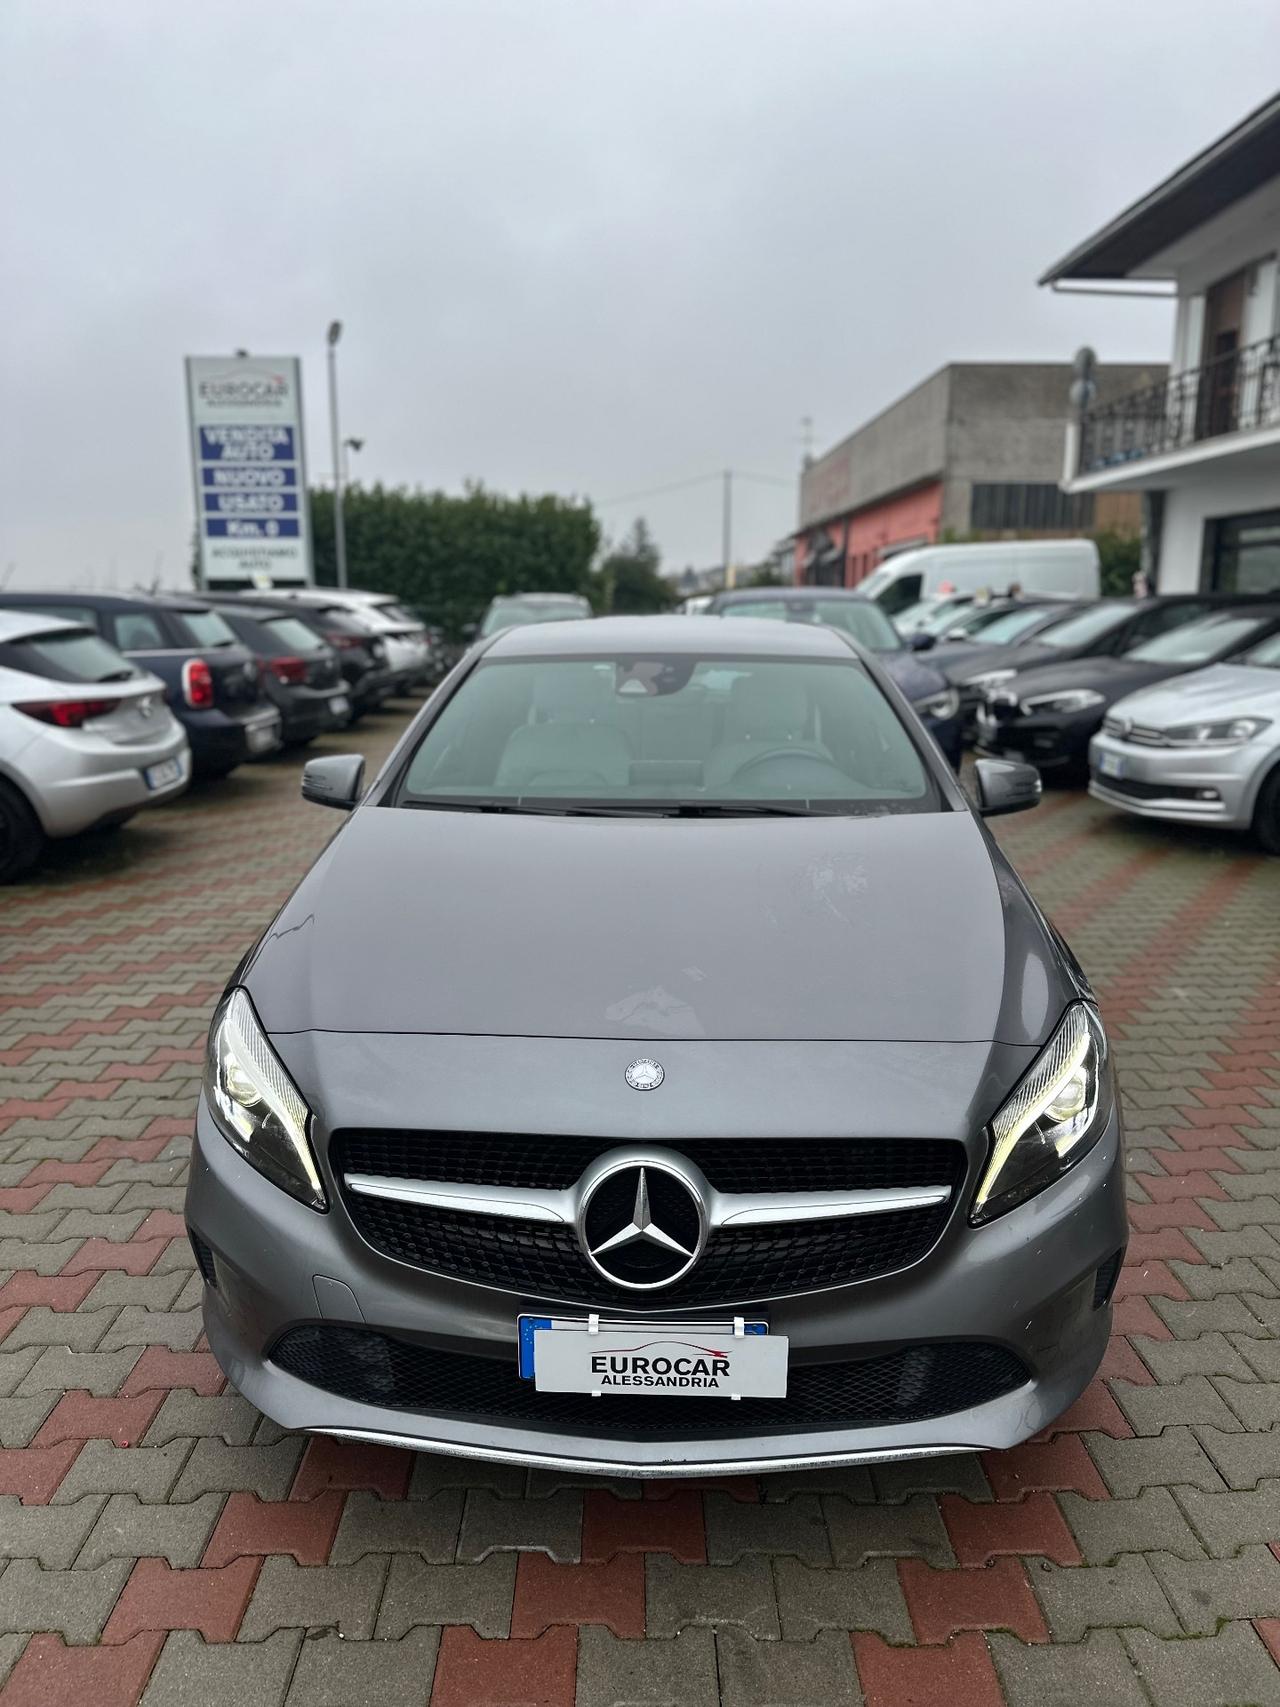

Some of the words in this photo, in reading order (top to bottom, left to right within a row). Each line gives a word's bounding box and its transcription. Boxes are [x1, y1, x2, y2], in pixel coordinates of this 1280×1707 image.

[214, 468, 286, 486] NUOVO
[218, 493, 284, 511] USATO
[591, 1356, 730, 1377] EUROCAR
[601, 1375, 719, 1388] ALESSANDRIA
